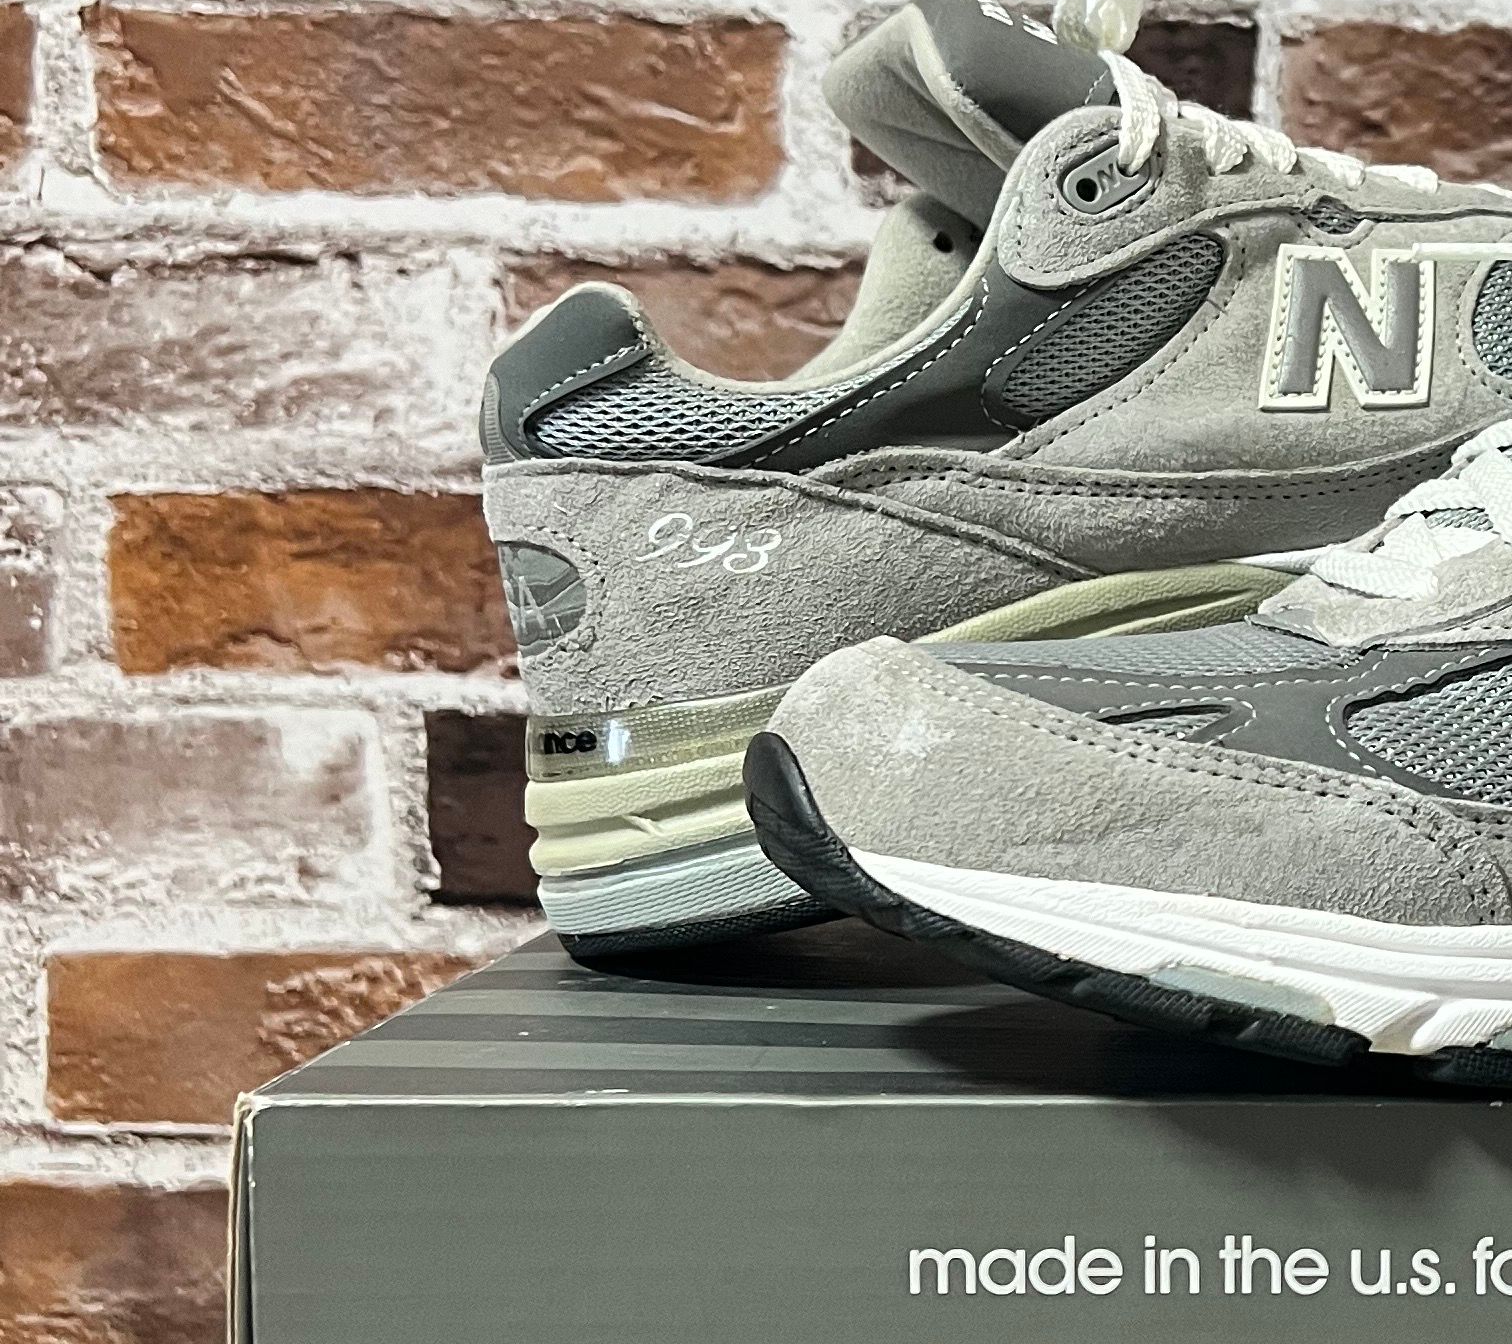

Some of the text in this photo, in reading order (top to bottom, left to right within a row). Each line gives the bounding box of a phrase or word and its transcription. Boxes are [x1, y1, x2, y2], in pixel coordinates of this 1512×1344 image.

[1258, 243, 1436, 411] N
[634, 512, 783, 574] 993
[541, 731, 598, 756] nce
[909, 1235, 1124, 1295] made
[1144, 1234, 1200, 1294] in
[1218, 1234, 1330, 1296] the
[1350, 1248, 1456, 1296] u.s.
